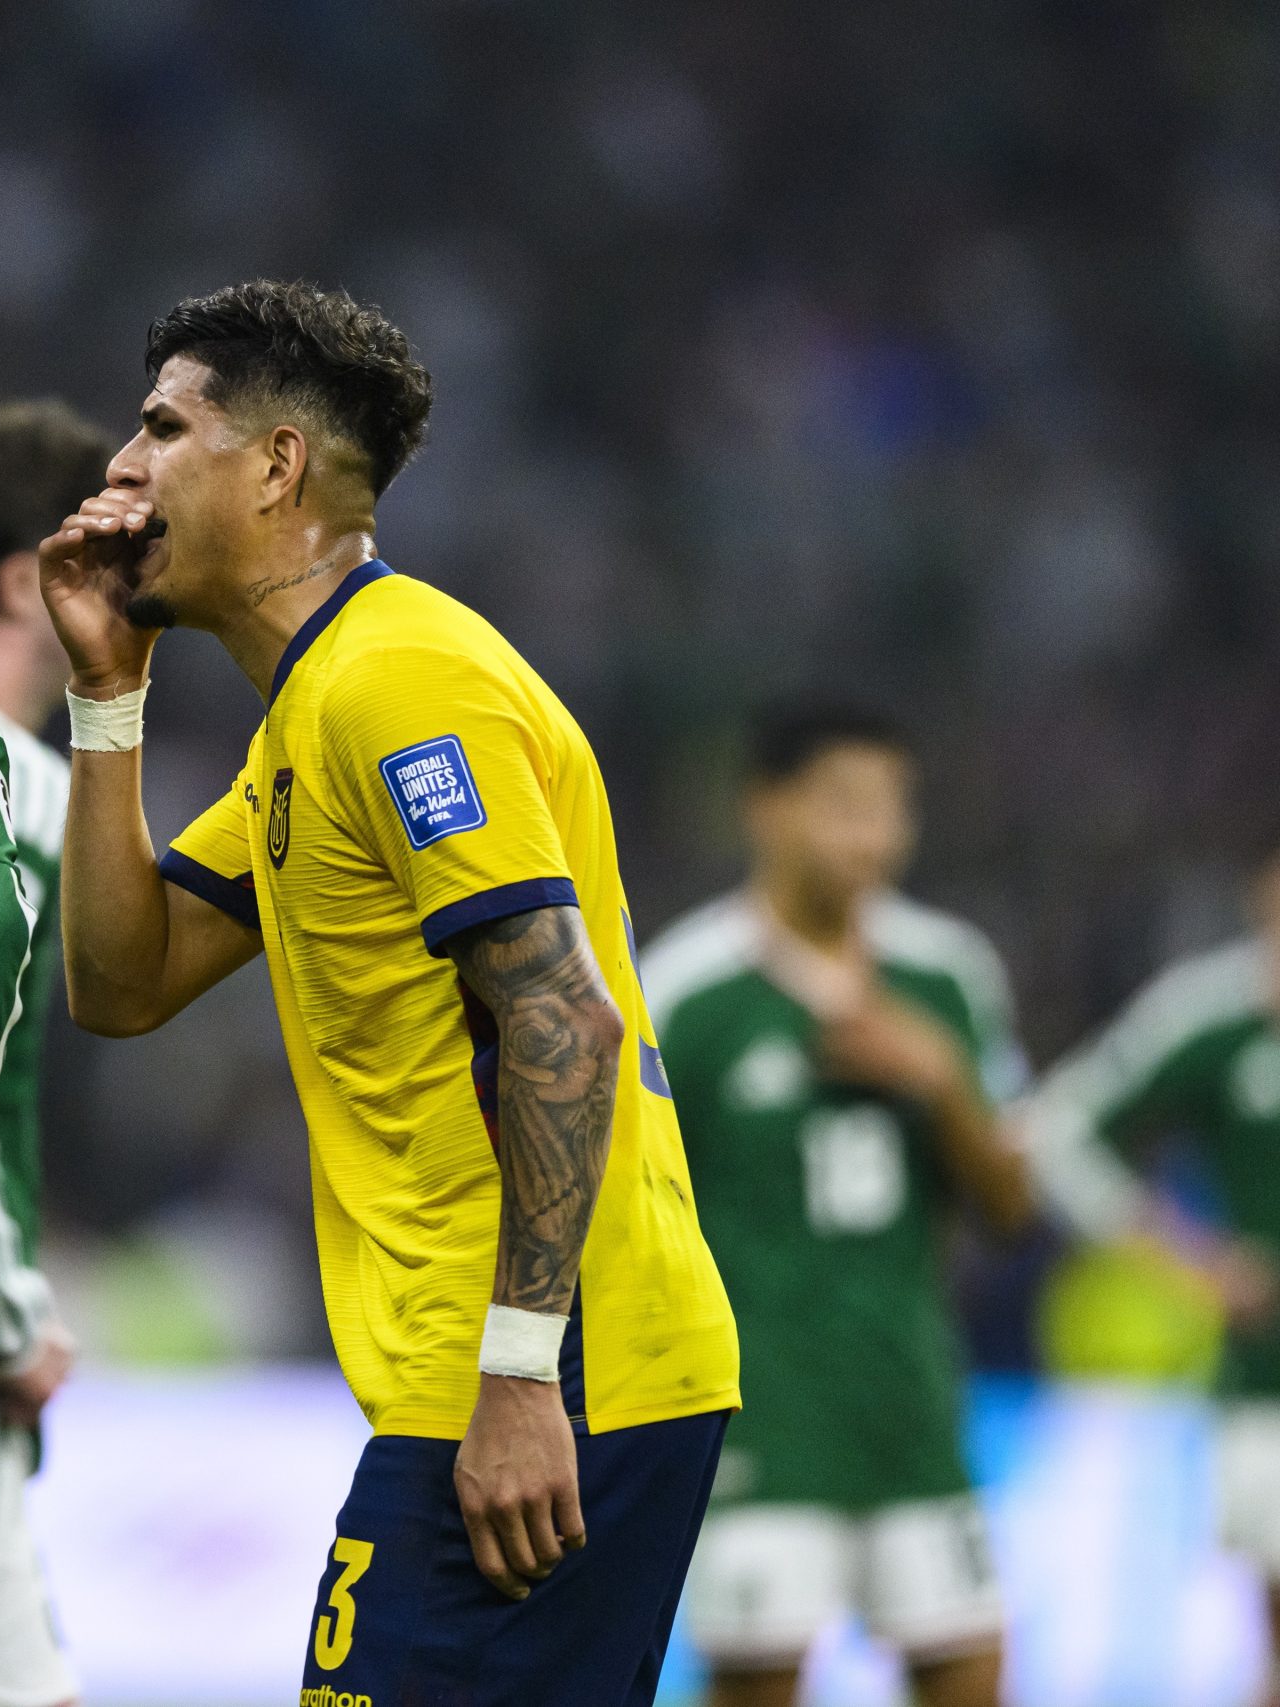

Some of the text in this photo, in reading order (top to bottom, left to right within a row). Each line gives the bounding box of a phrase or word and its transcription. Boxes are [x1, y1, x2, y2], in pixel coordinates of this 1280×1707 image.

[396, 754, 451, 783] FOOTBALL
[402, 767, 457, 802] UNITES
[408, 786, 466, 821] the World
[427, 811, 451, 825] FIFA
[315, 1536, 374, 1670] 3
[299, 1684, 372, 1707] arathon
